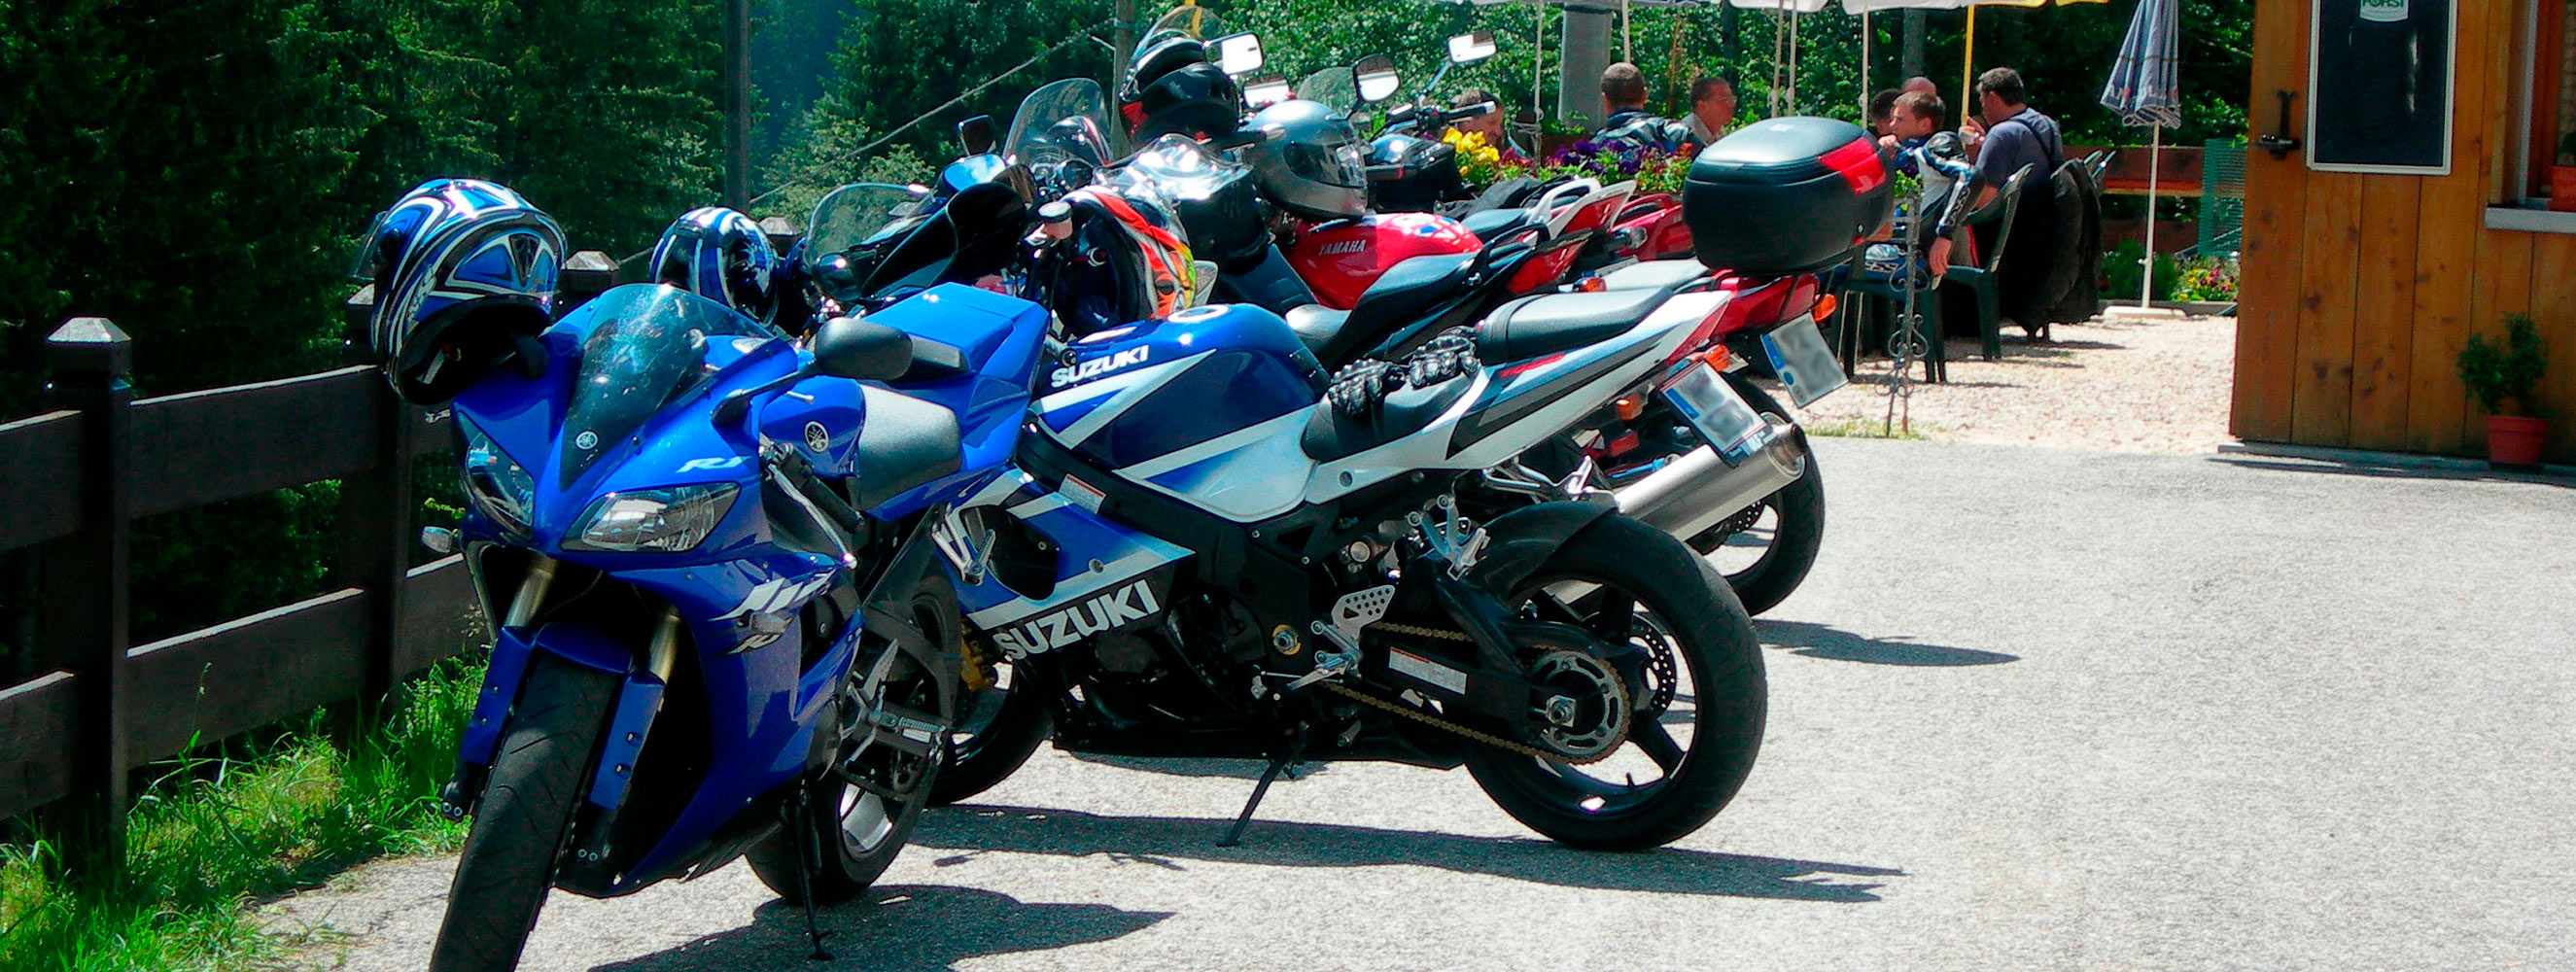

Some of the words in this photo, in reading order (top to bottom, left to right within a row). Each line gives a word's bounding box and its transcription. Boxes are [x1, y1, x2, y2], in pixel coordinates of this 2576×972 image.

[1318, 239, 1367, 256] YAMAHA
[1051, 344, 1150, 388] SUZUKI
[992, 578, 1161, 660] SUZUKI
